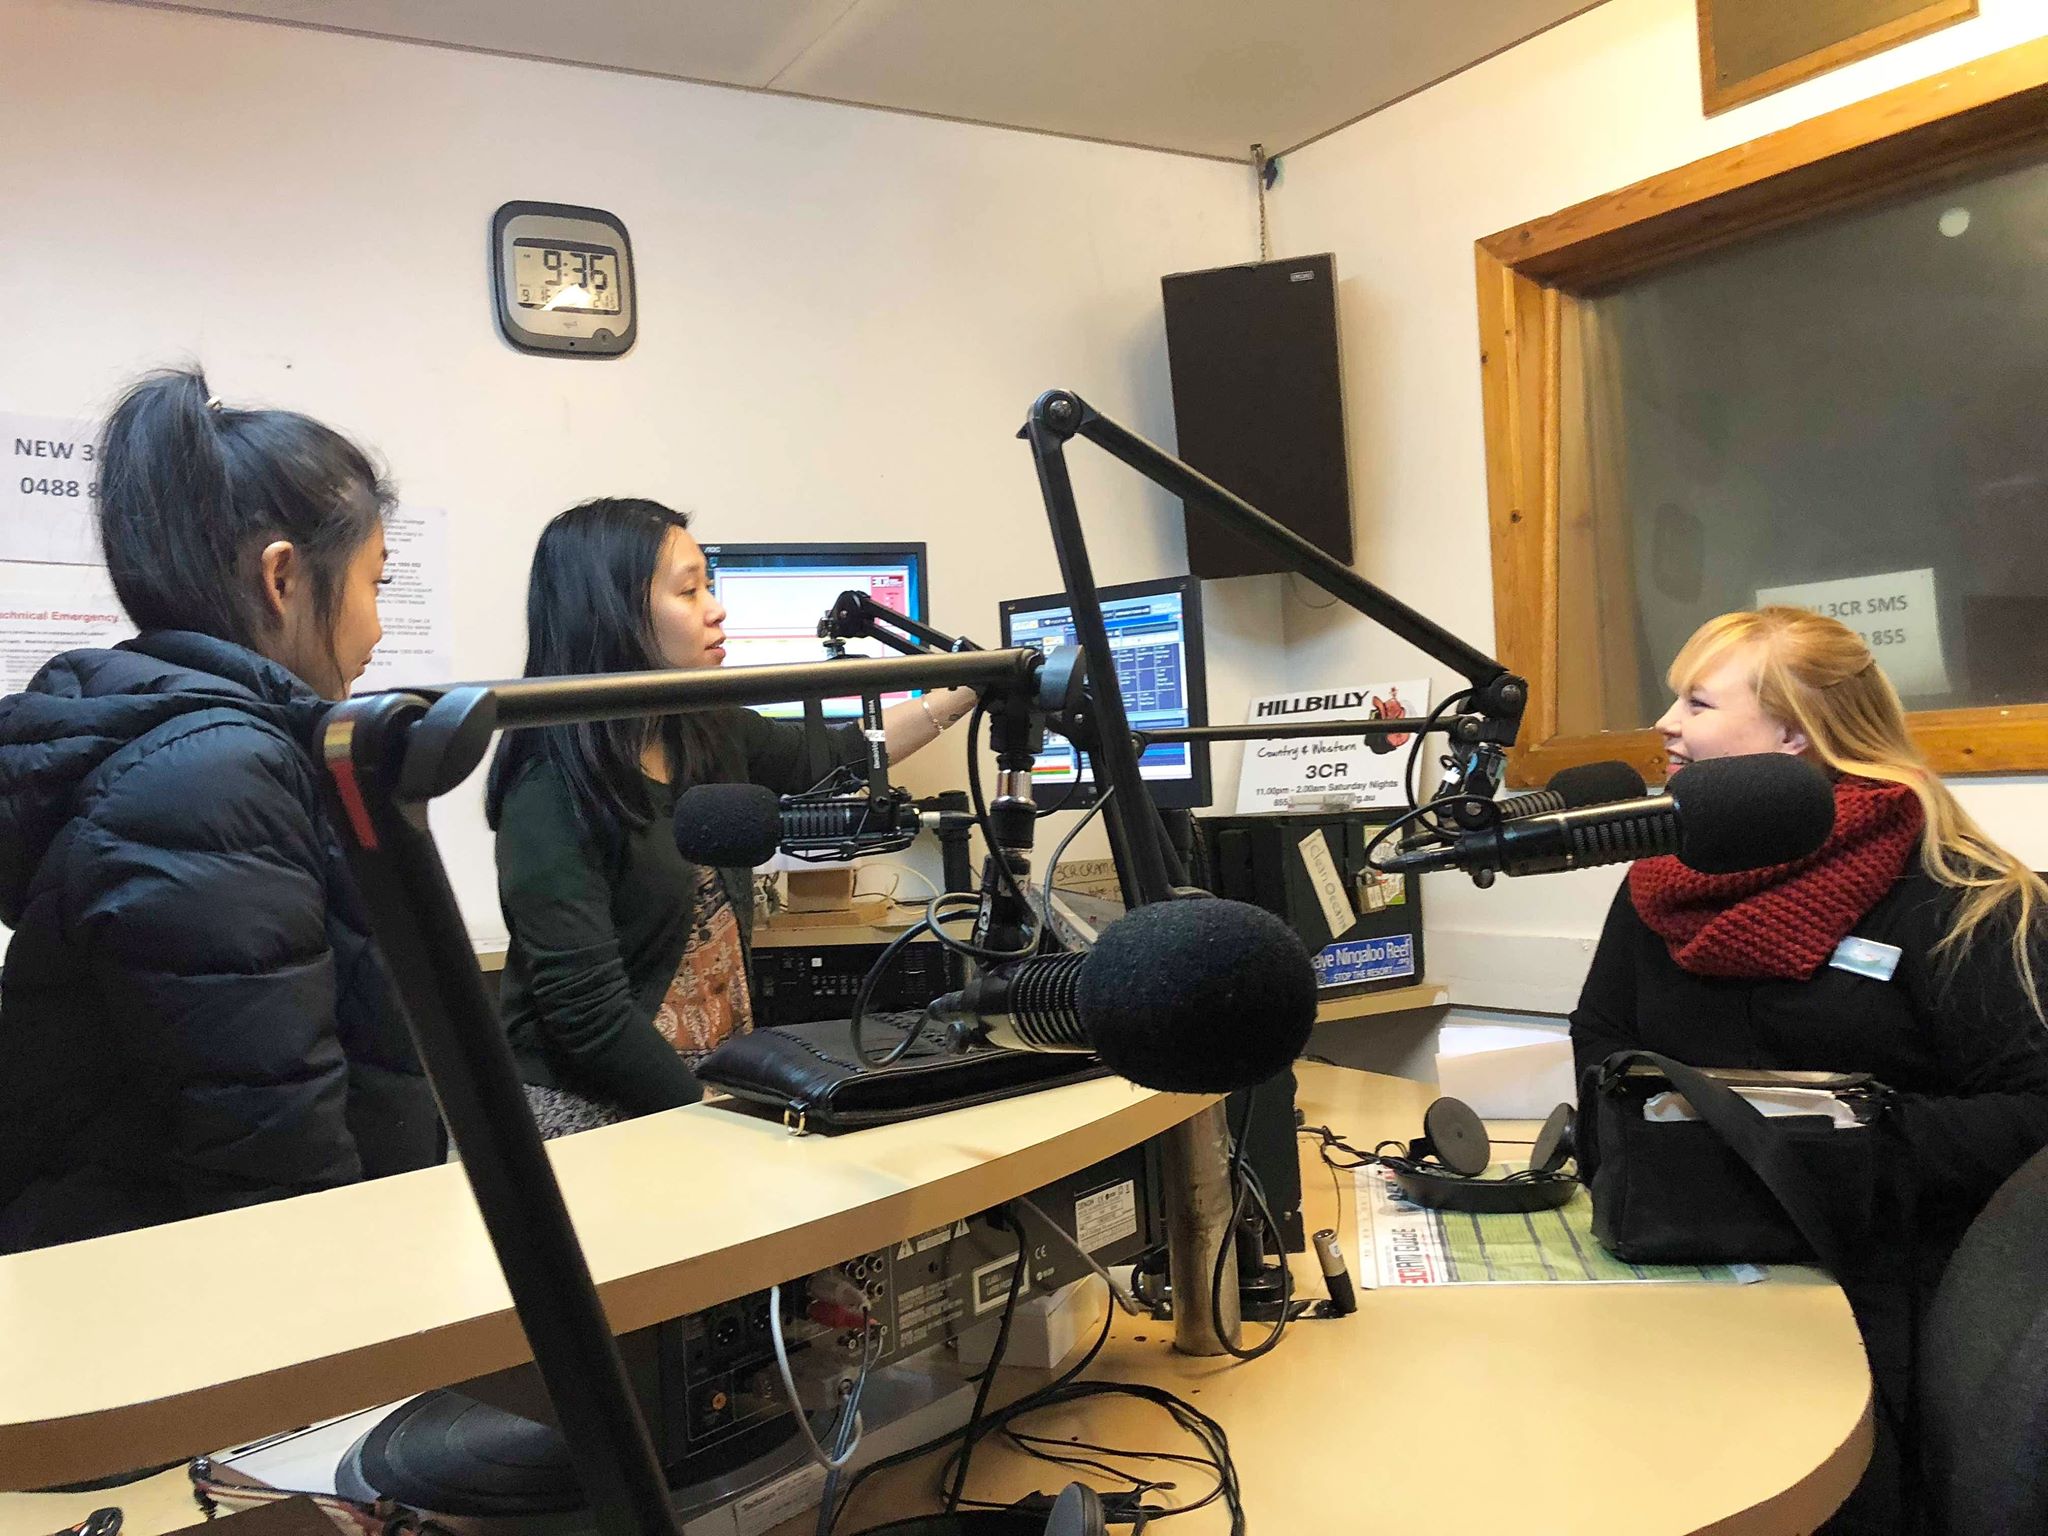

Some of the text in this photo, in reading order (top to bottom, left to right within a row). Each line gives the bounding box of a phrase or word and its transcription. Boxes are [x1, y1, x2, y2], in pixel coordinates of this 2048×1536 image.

[543, 250, 608, 290] 9:36
[14, 438, 94, 461] NEW 3
[20, 477, 101, 498] 0488 8
[1828, 601, 1862, 618] 3CR
[1867, 595, 1908, 614] SMS
[51, 611, 119, 623] Emergency
[1872, 629, 1906, 646] 855
[1257, 690, 1370, 717] HILLBILLY
[1257, 746, 1301, 760] Country
[1312, 742, 1357, 755] Western
[1305, 763, 1348, 779] 3CR
[1328, 782, 1367, 793] Saturday
[1369, 780, 1398, 791] Nights
[1336, 944, 1384, 968] Ningaloo
[1386, 939, 1411, 959] Reef
[1334, 972, 1351, 982] STOP
[1352, 970, 1366, 979] THE
